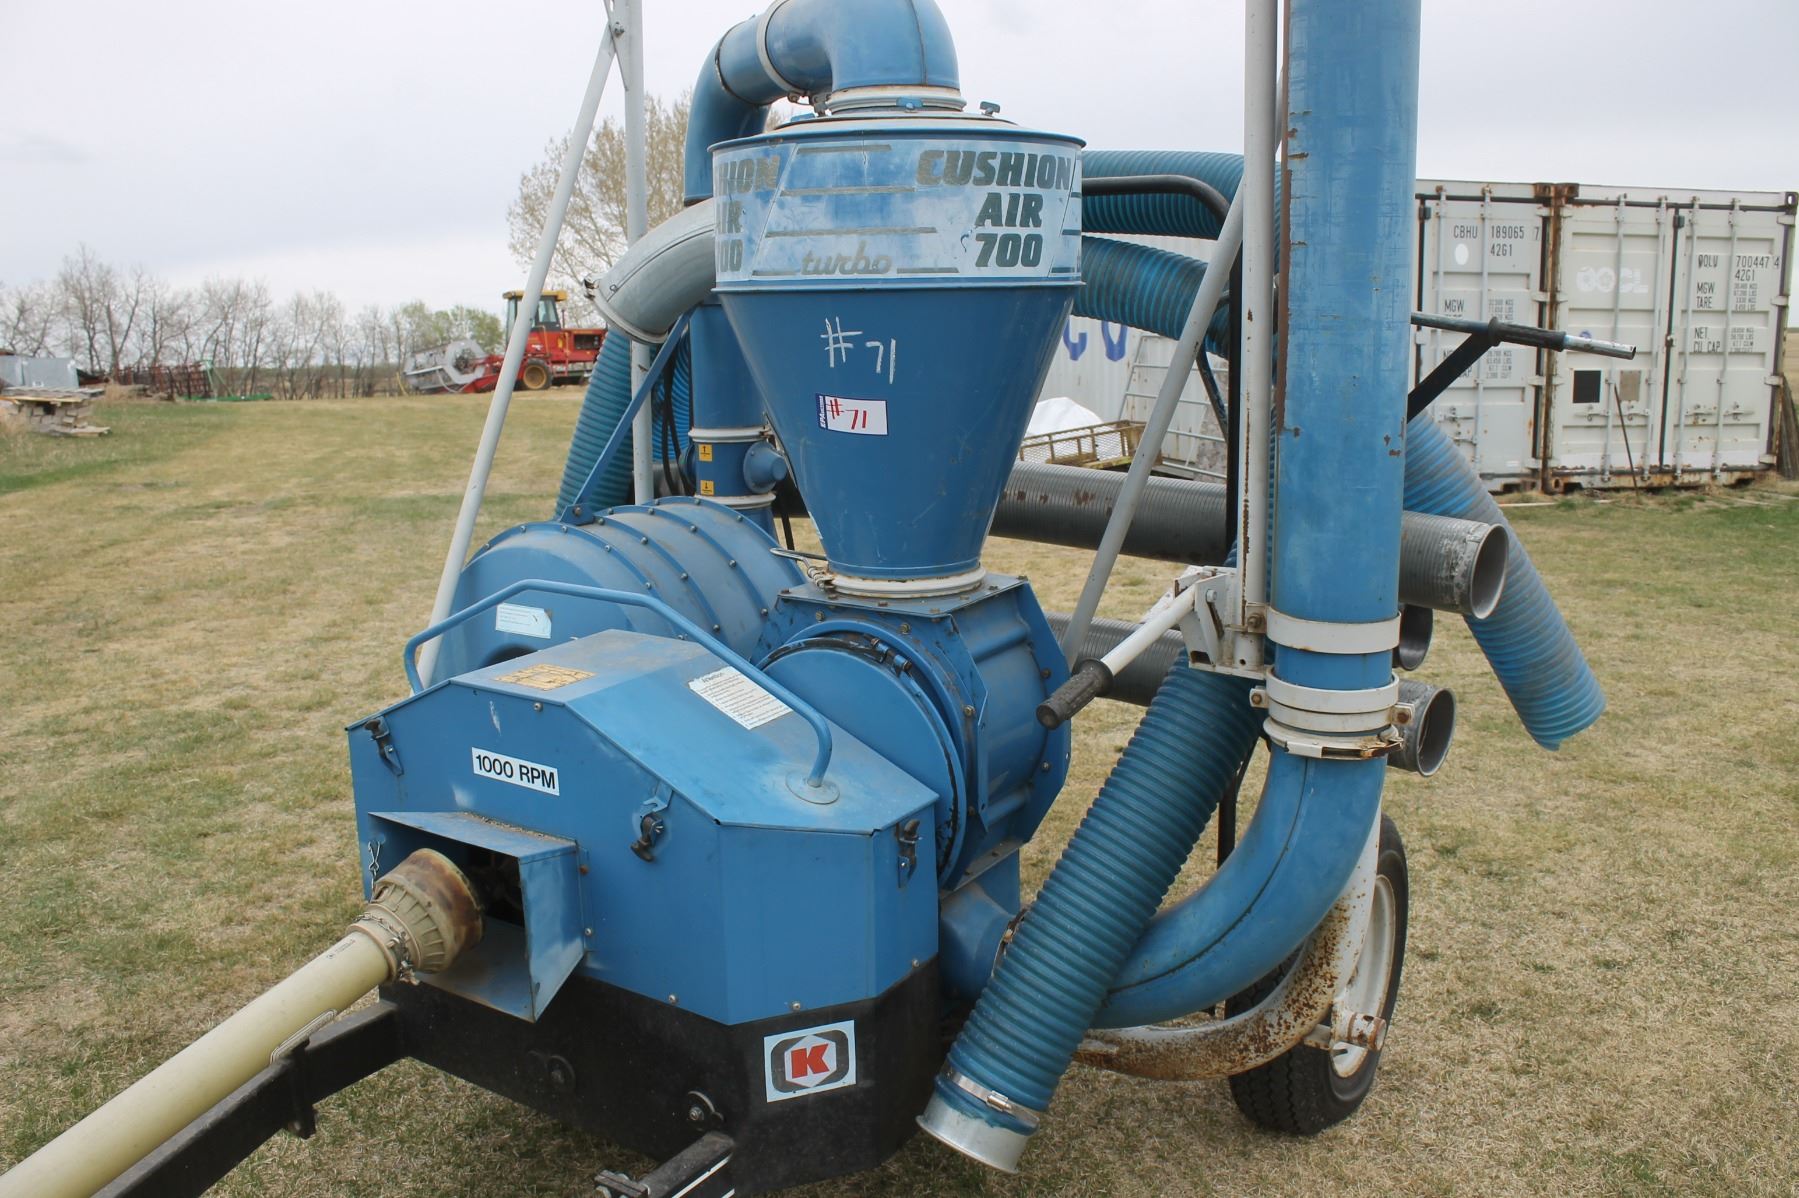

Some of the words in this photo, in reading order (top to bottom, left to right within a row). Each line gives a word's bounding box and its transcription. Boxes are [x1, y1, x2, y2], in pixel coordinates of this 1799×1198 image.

[915, 150, 1072, 191] CUSHION
[974, 192, 1044, 228] AIR
[1453, 225, 1478, 239] CBHU
[1490, 225, 1525, 239] 189065
[1534, 226, 1540, 240] 7
[974, 232, 1044, 268] 700
[1490, 243, 1513, 257] 42G1
[801, 241, 892, 276] turbo
[1736, 255, 1769, 268] 700447
[1696, 282, 1715, 294] MGW
[1444, 300, 1465, 313] MGW
[1696, 296, 1713, 309] TARE
[1694, 327, 1709, 339] NET
[475, 754, 514, 779] 1000
[519, 764, 556, 790] RPM
[791, 1043, 830, 1079] K
